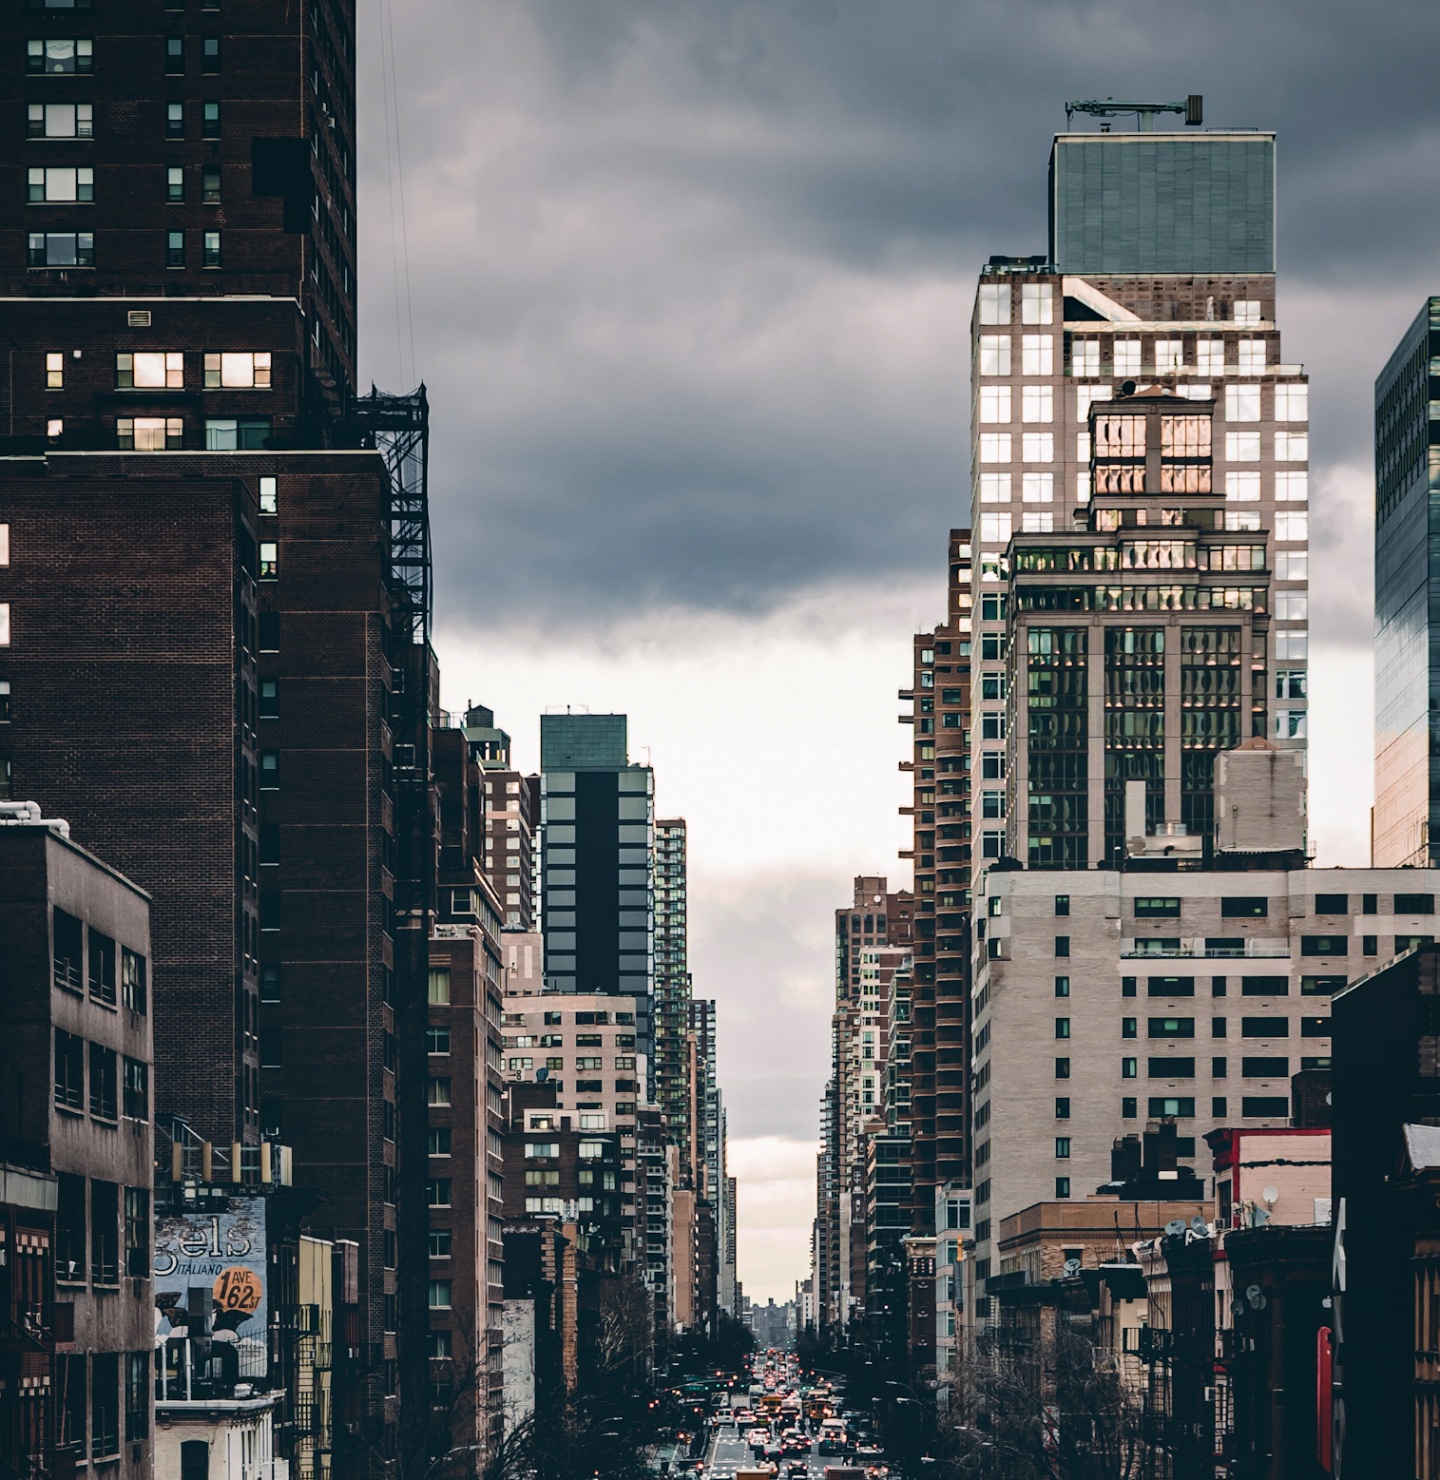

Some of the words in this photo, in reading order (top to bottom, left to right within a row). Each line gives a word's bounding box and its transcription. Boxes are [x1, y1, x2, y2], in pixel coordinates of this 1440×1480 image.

[177, 1263, 222, 1276] ITALIANO
[219, 1271, 231, 1300] 1
[231, 1271, 253, 1284] AVE
[226, 1286, 254, 1309] 62
[249, 1296, 262, 1309] ST
